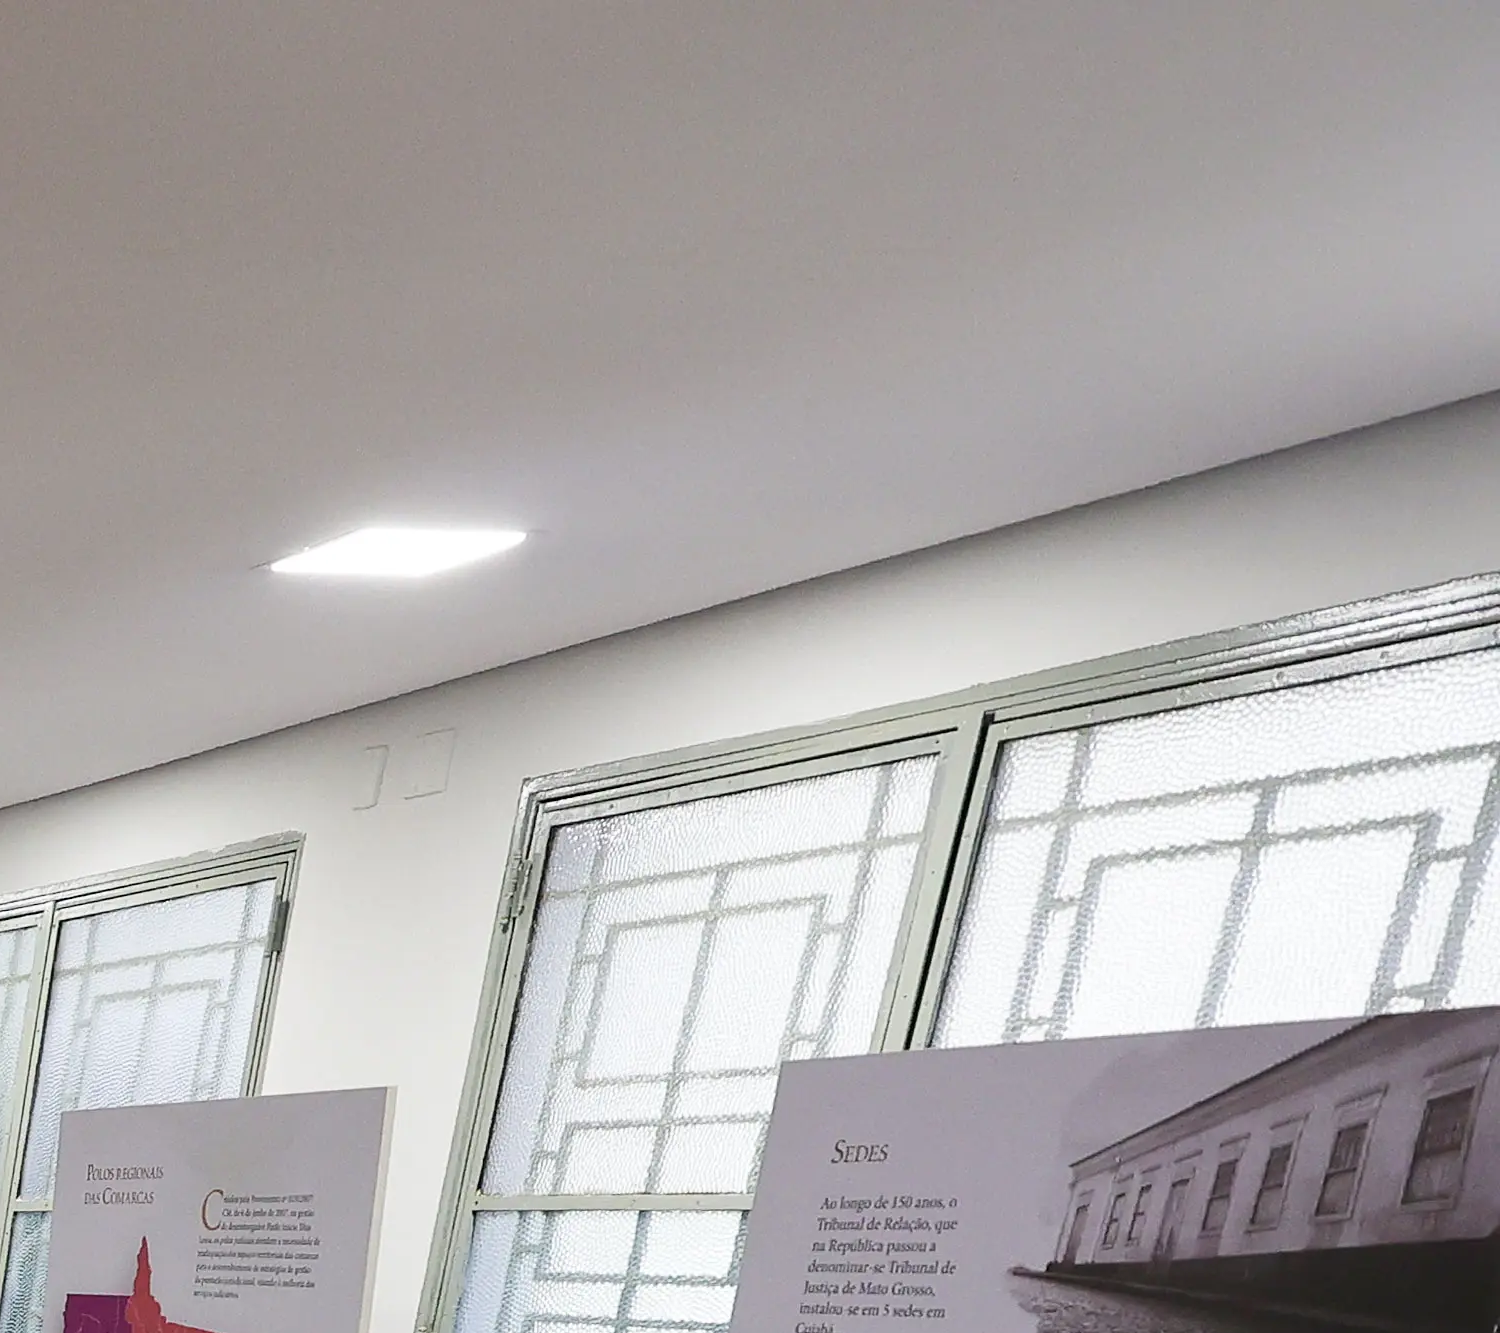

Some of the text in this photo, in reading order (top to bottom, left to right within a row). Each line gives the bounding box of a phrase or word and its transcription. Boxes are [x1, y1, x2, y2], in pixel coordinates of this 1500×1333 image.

[831, 1139, 889, 1164] SEDES
[86, 1164, 164, 1181] POLOS REGIONAIS
[84, 1187, 155, 1204] DAS COMARCAS
[820, 1195, 957, 1213] Ao longo de 150 anos, o
[817, 1217, 958, 1234] Tribunal de Relação, que
[812, 1238, 936, 1255] na República passou a
[807, 1260, 956, 1275] denominar-se Tribunal de
[804, 1281, 935, 1297] Justiça de Mato Grosso,
[799, 1302, 945, 1319] instalou-se em 5 sedes em
